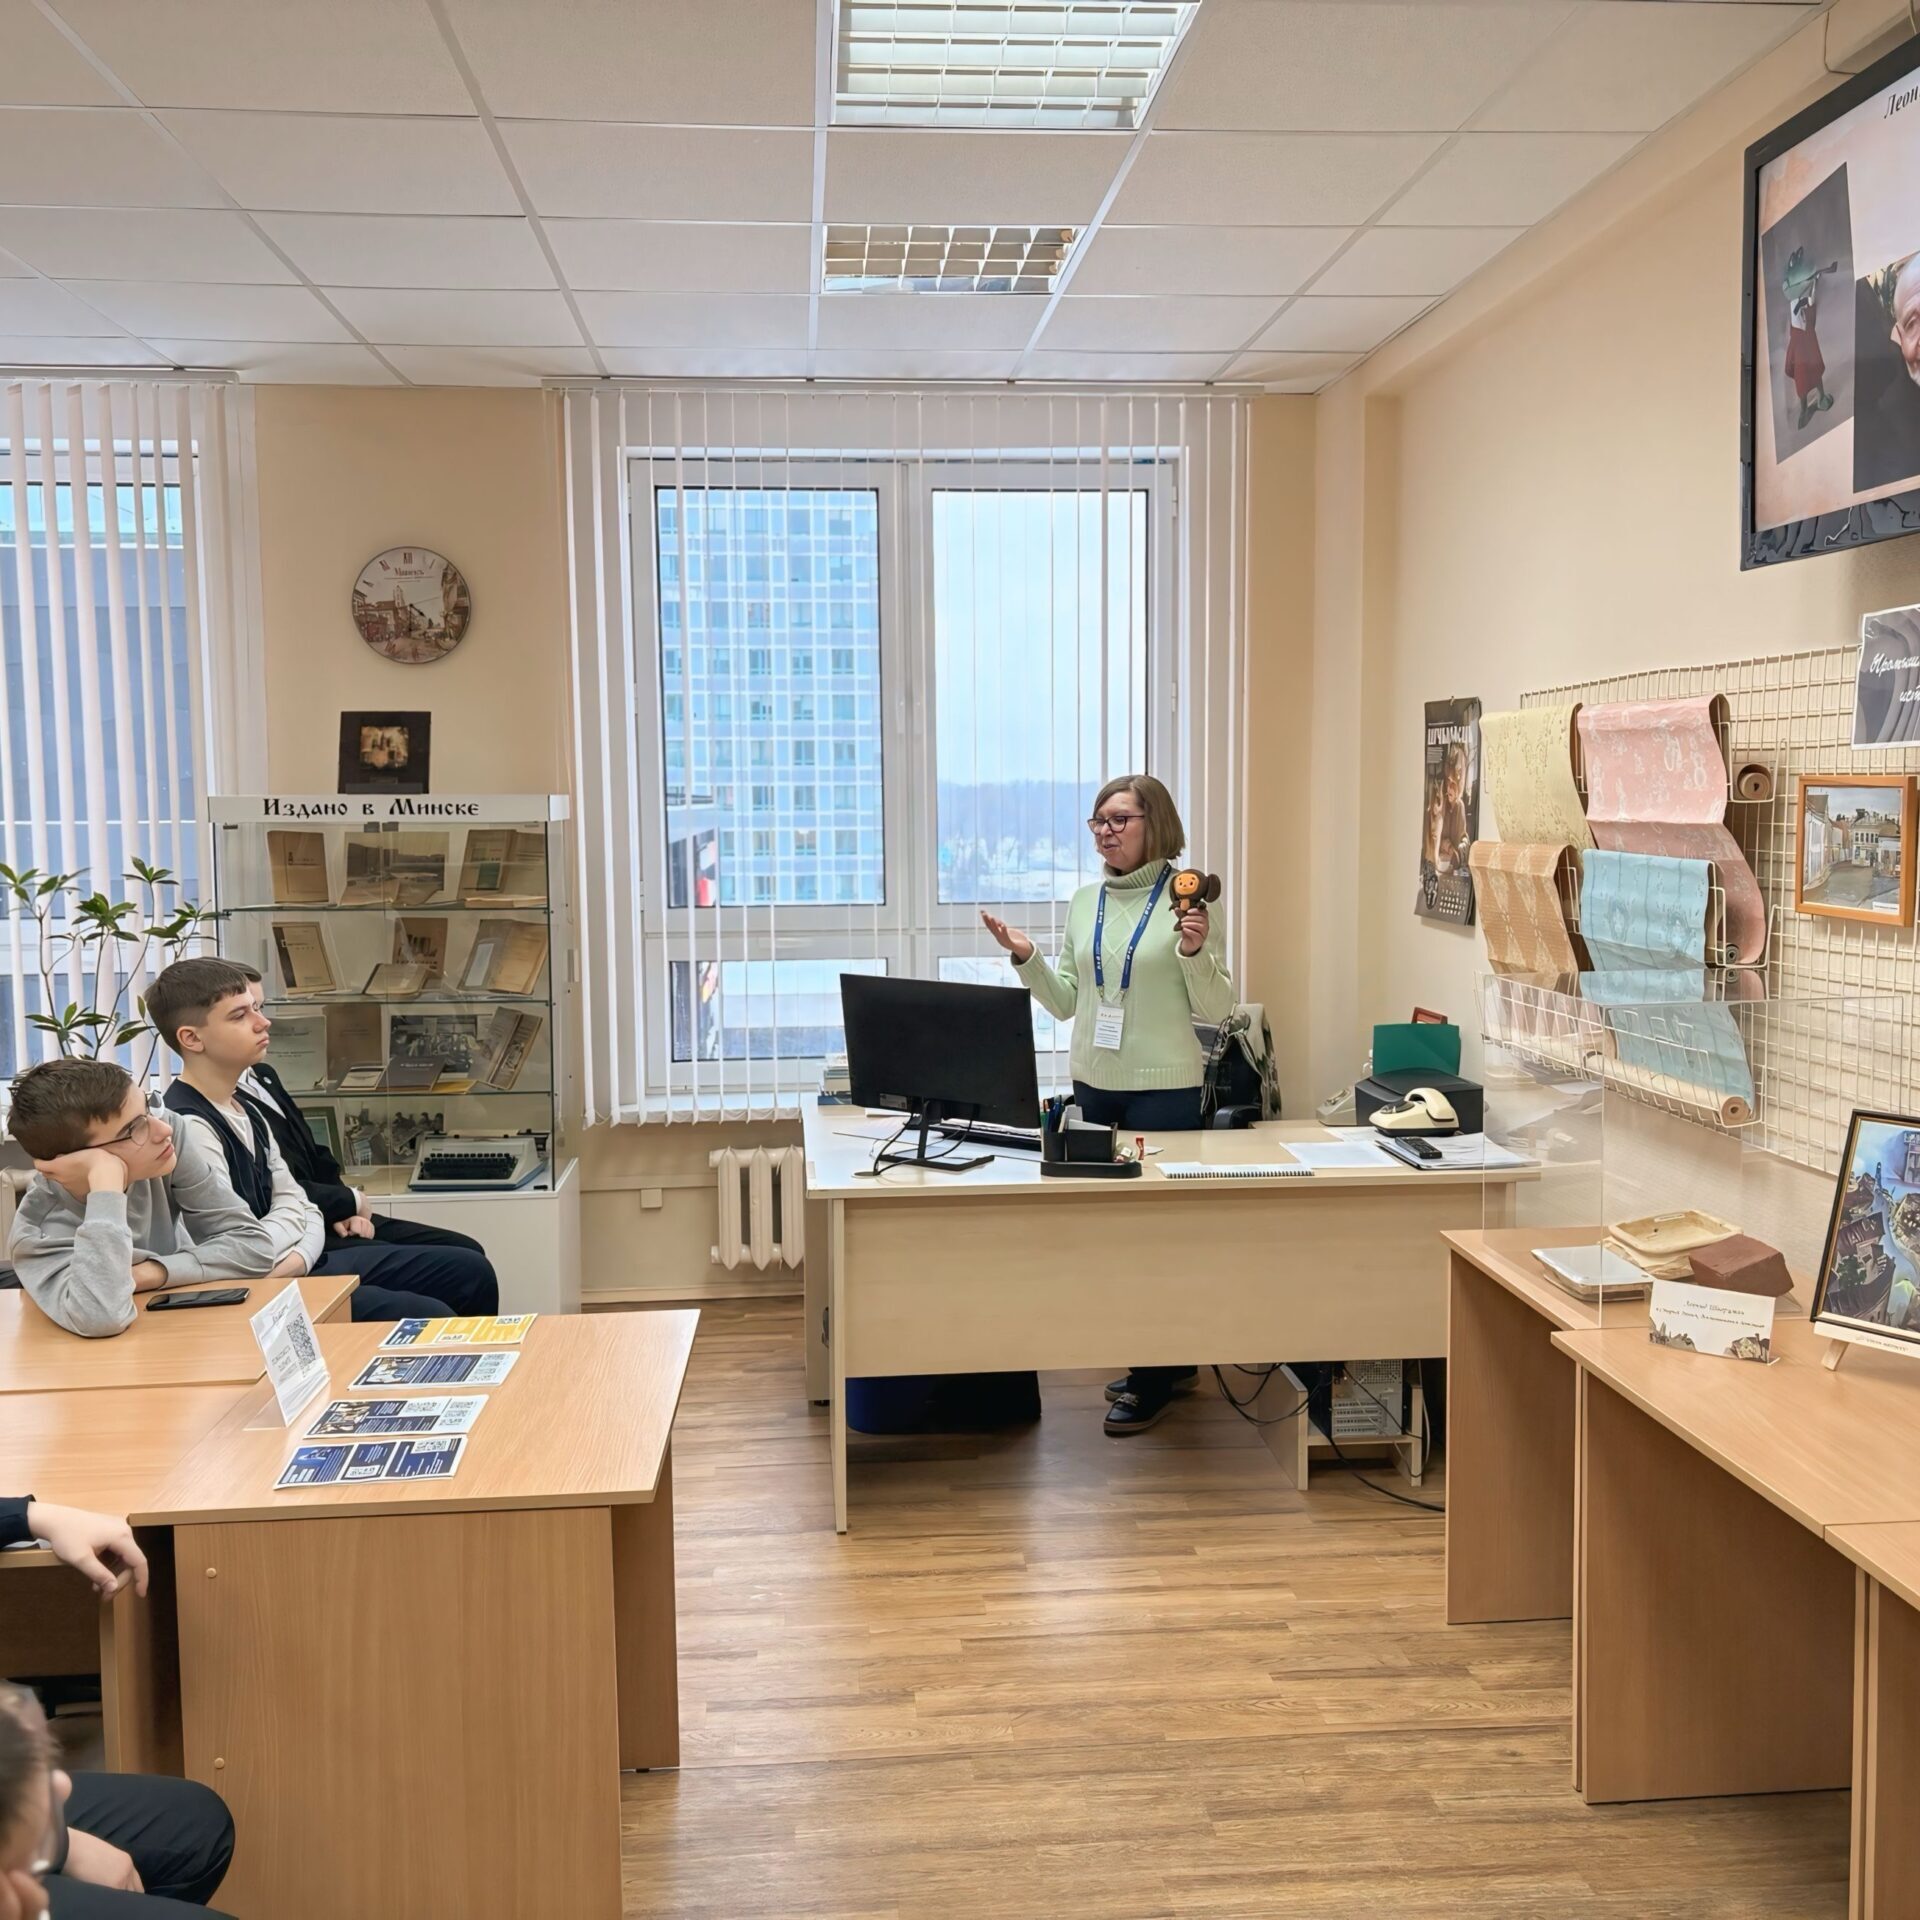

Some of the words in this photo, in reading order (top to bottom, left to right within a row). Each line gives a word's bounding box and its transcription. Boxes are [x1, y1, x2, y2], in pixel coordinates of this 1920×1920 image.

[1883, 85, 1920, 119] Леон
[263, 798, 348, 819] Издано
[362, 802, 375, 816] в
[389, 798, 480, 816] Минске
